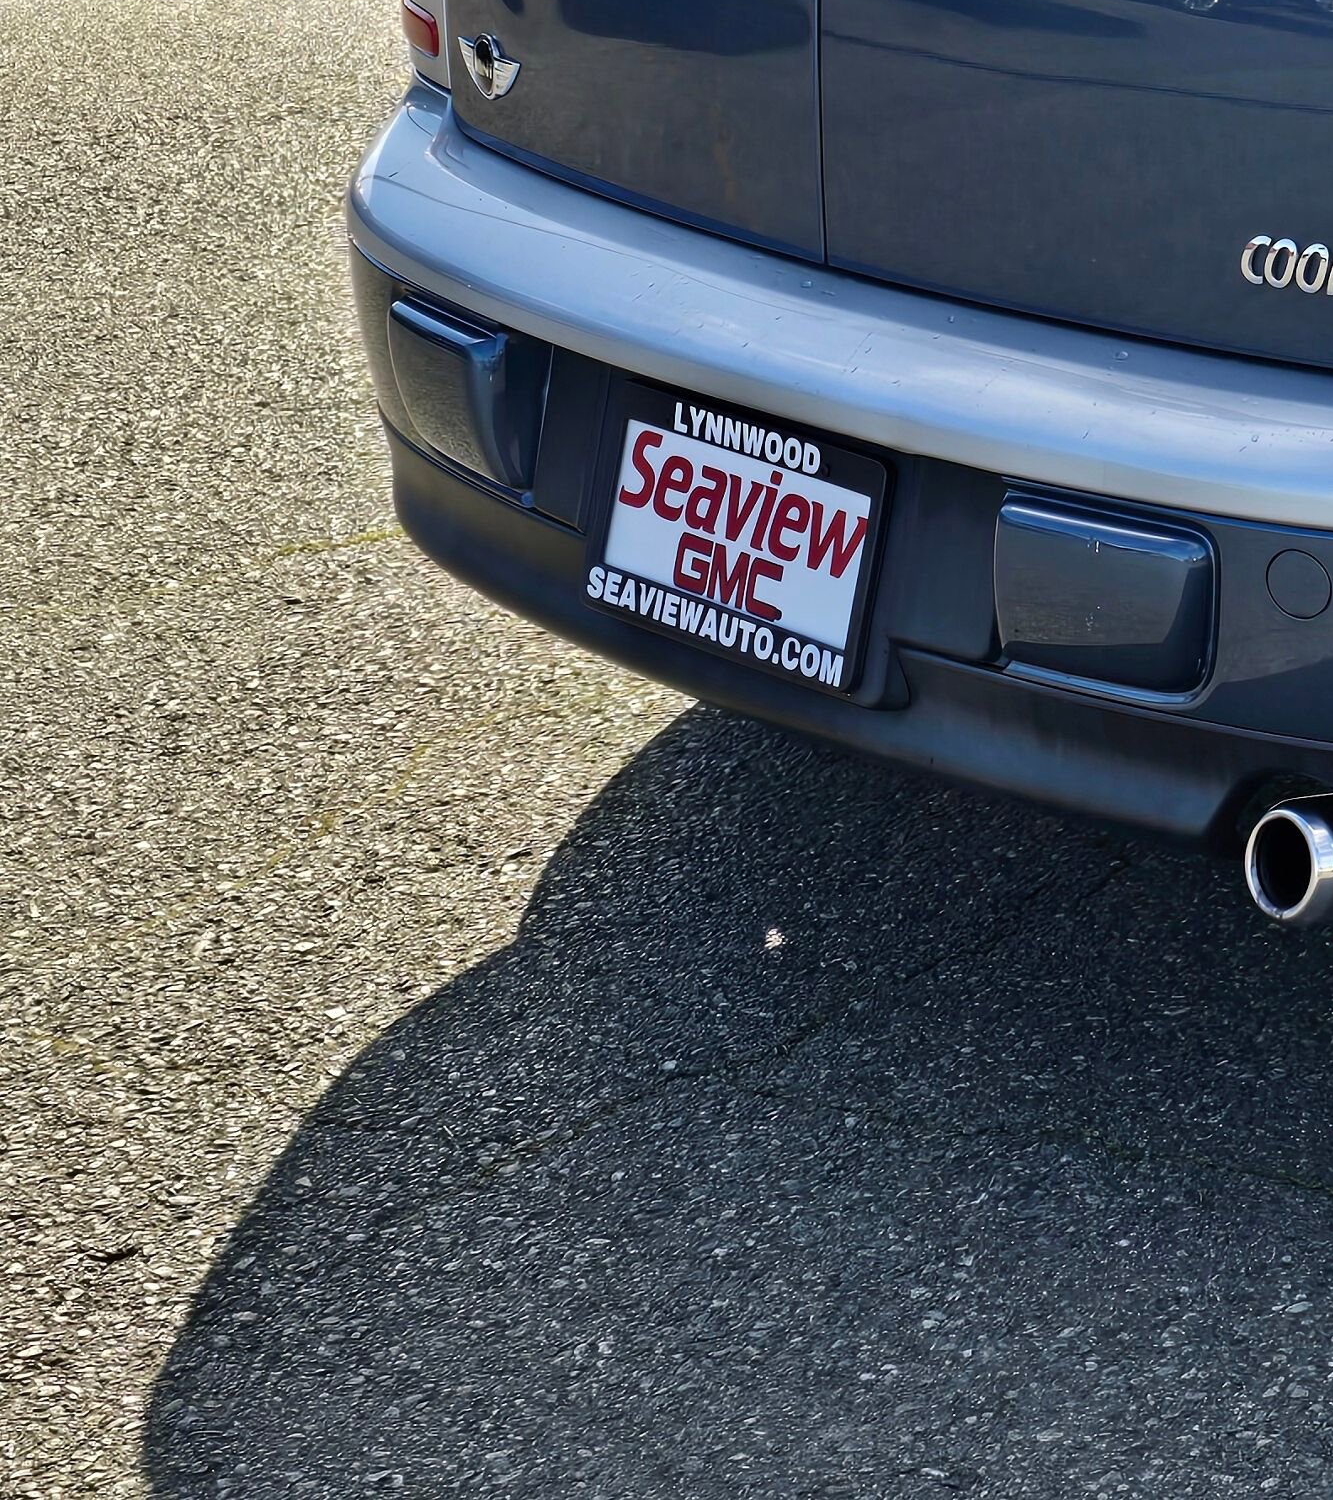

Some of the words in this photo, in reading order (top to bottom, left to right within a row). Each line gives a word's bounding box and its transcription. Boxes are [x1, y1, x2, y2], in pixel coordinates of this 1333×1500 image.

[674, 402, 821, 475] LYNNWOOD
[618, 430, 869, 579] Seaview
[586, 565, 844, 688] SEAVIEWAUTO.COM
[672, 532, 784, 622] GMC
